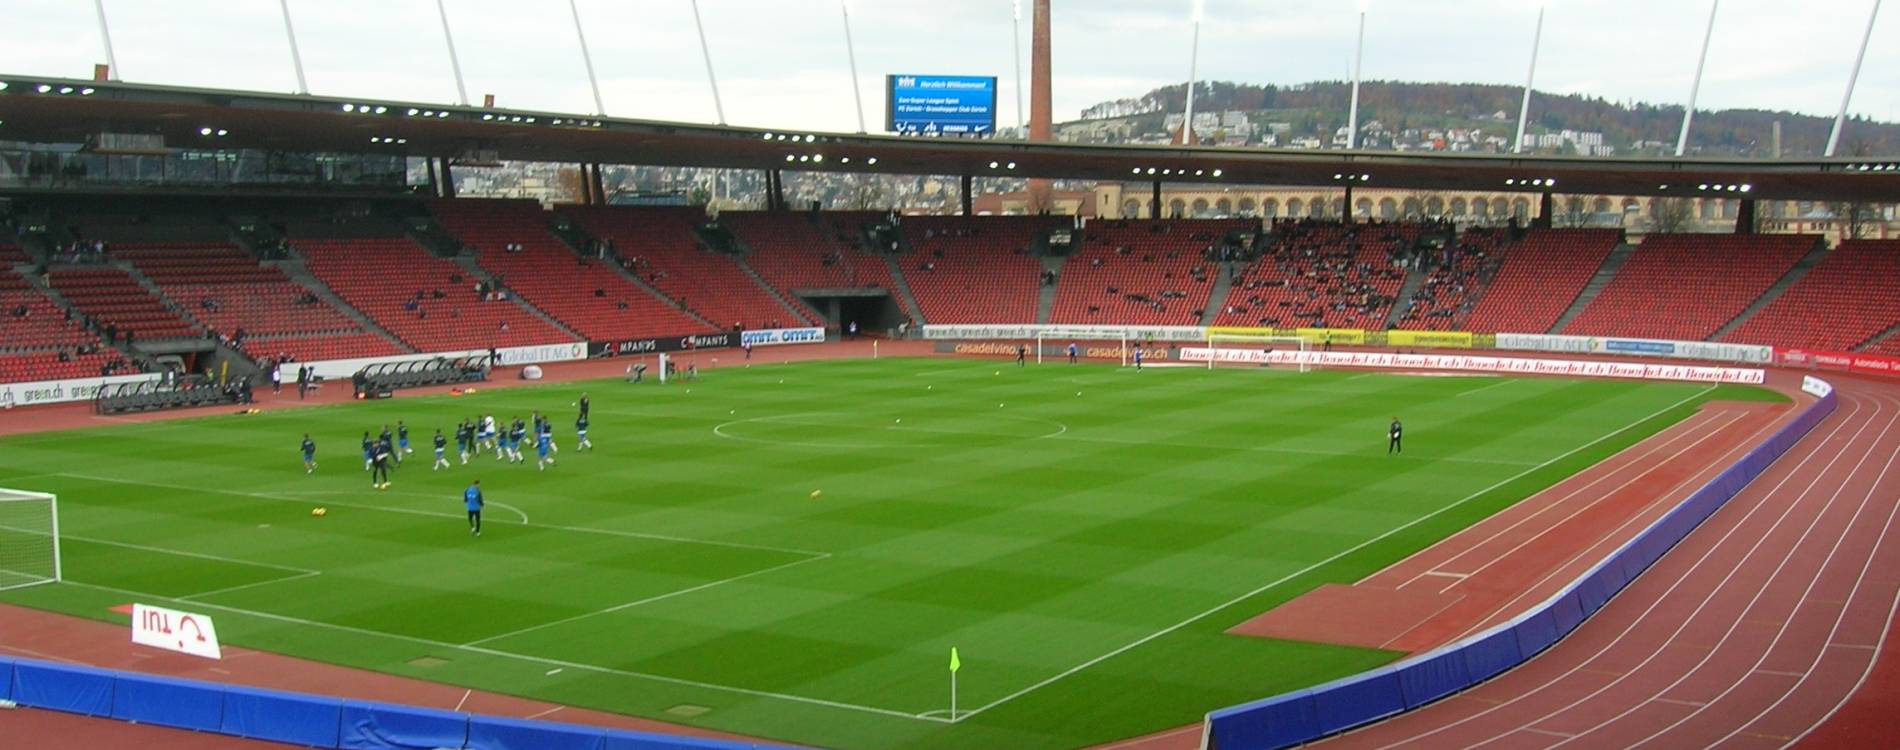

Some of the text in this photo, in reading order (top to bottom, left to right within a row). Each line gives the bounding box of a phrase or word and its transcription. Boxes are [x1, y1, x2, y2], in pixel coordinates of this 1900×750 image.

[502, 347, 567, 363] Global IT AG
[25, 383, 63, 401] green.ch
[143, 609, 172, 635] TUI
